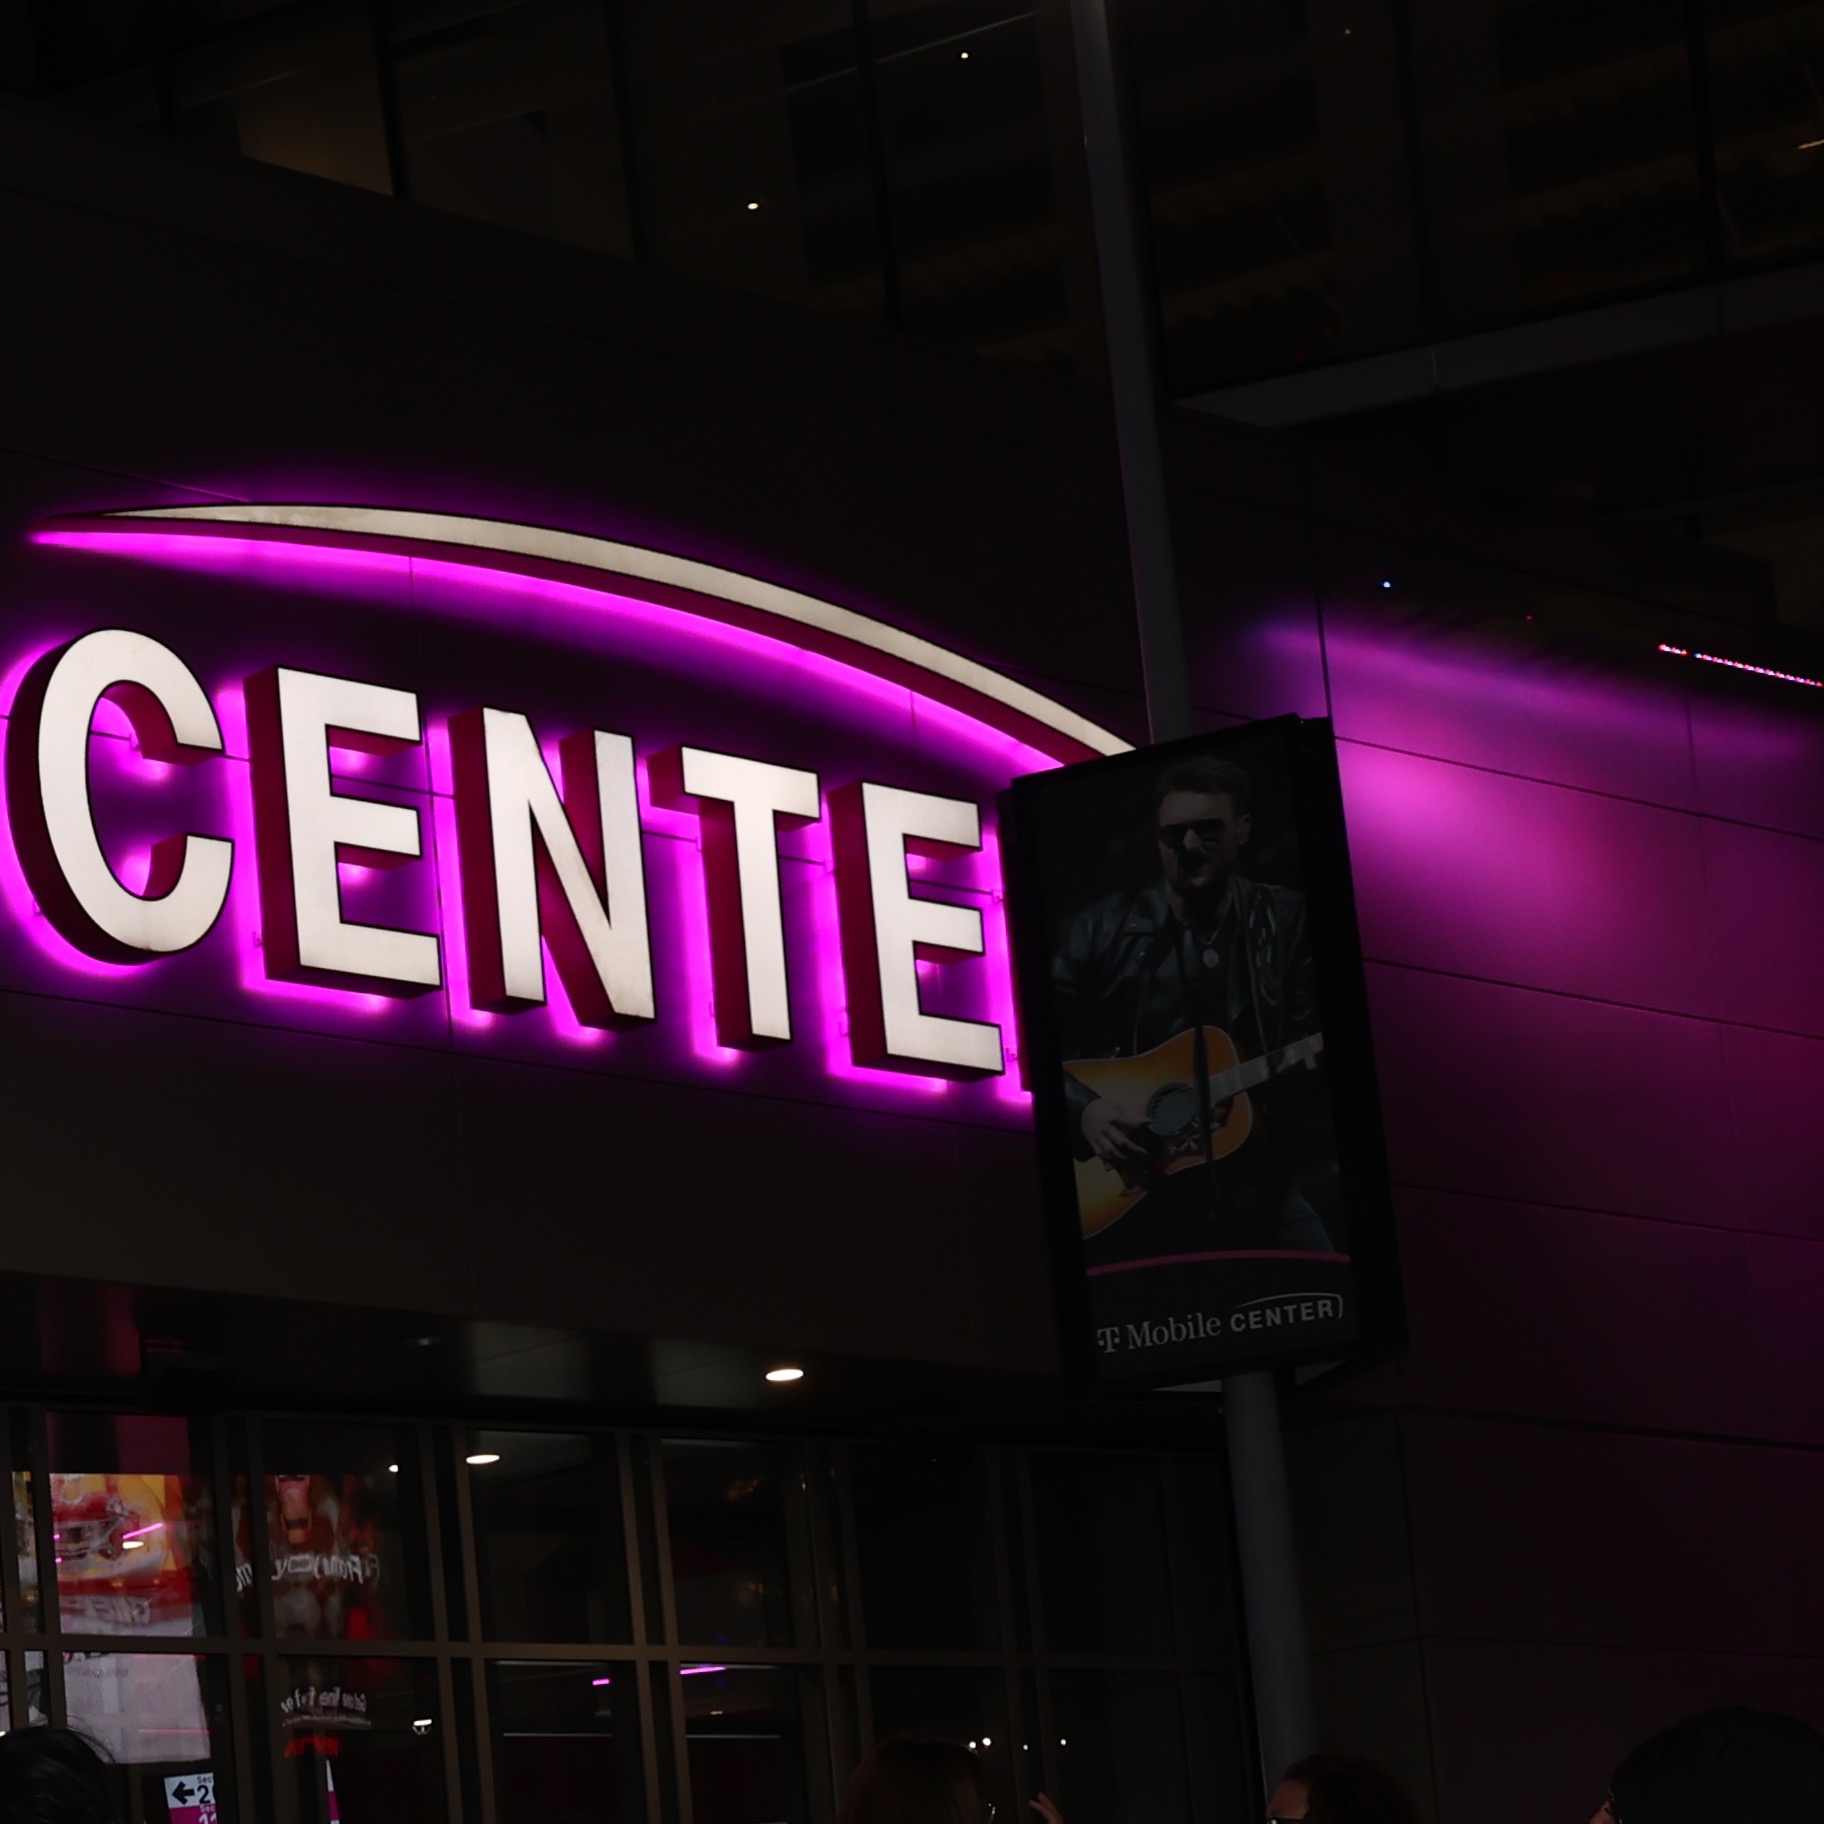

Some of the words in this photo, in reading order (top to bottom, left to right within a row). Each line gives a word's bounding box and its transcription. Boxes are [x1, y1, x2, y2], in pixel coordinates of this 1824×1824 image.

[10, 628, 1007, 1076] CENTE
[1096, 1326, 1121, 1354] T
[1125, 1312, 1222, 1350] Mobile
[1229, 1298, 1334, 1333] CENTER
